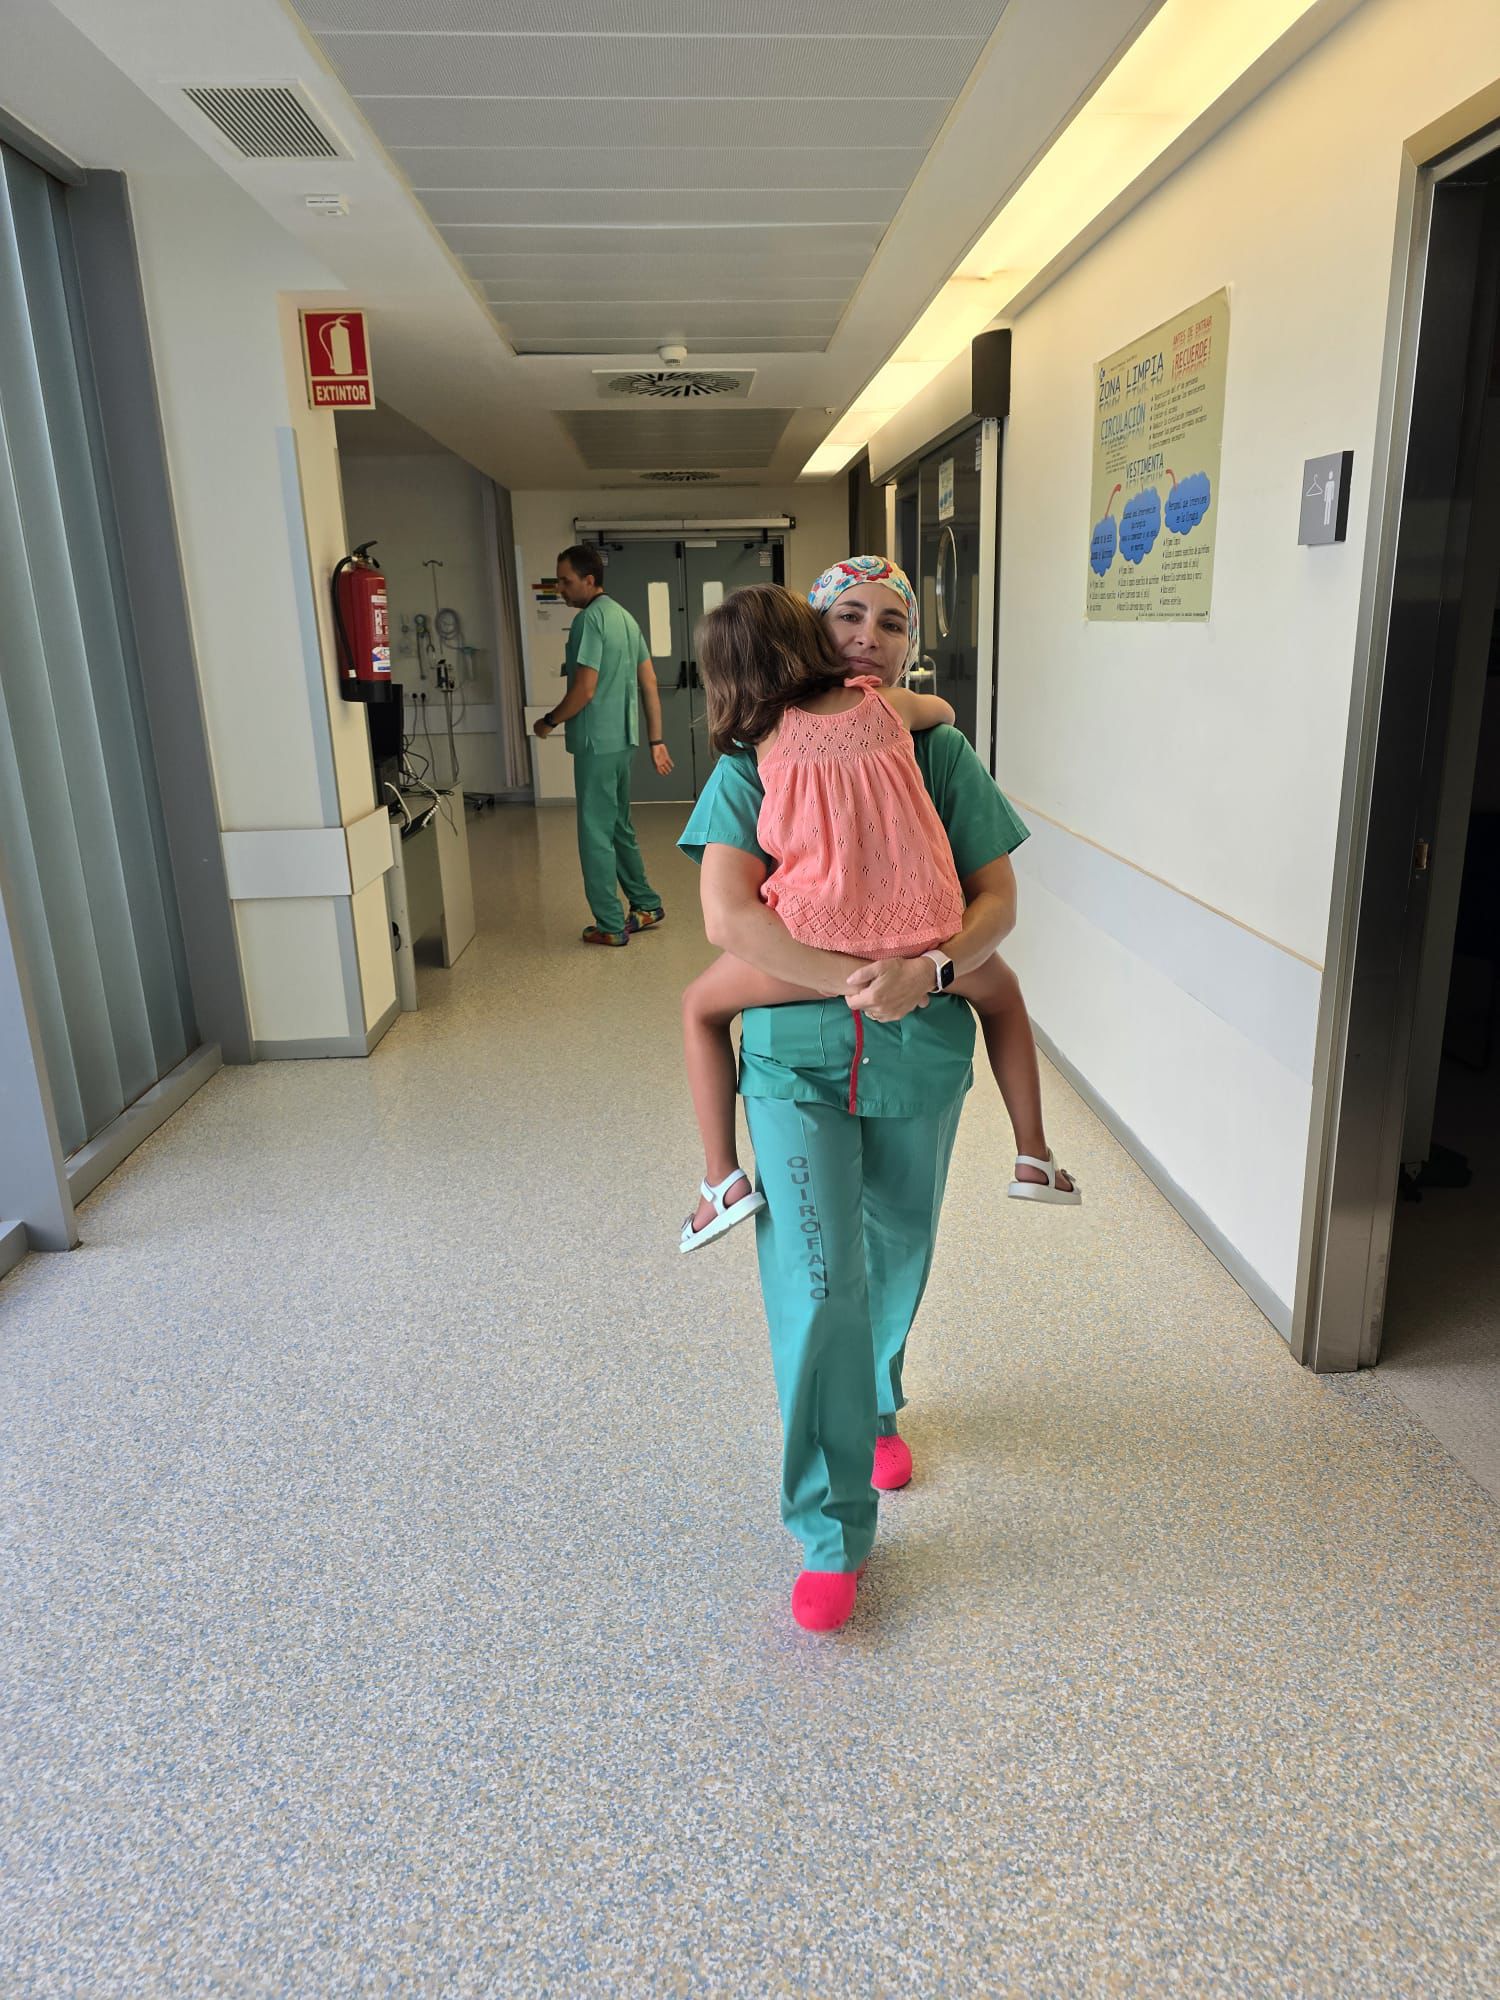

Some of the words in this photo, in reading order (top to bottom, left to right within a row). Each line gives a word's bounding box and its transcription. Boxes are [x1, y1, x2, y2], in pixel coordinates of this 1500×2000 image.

[1187, 325, 1194, 337] DE
[1099, 376, 1121, 402] ZONA
[1126, 352, 1164, 388] LIMPIA
[315, 384, 367, 402] EXTINTOR
[1101, 401, 1146, 439] CIRCULACIÓN
[1126, 453, 1164, 479] VESTIMENTA
